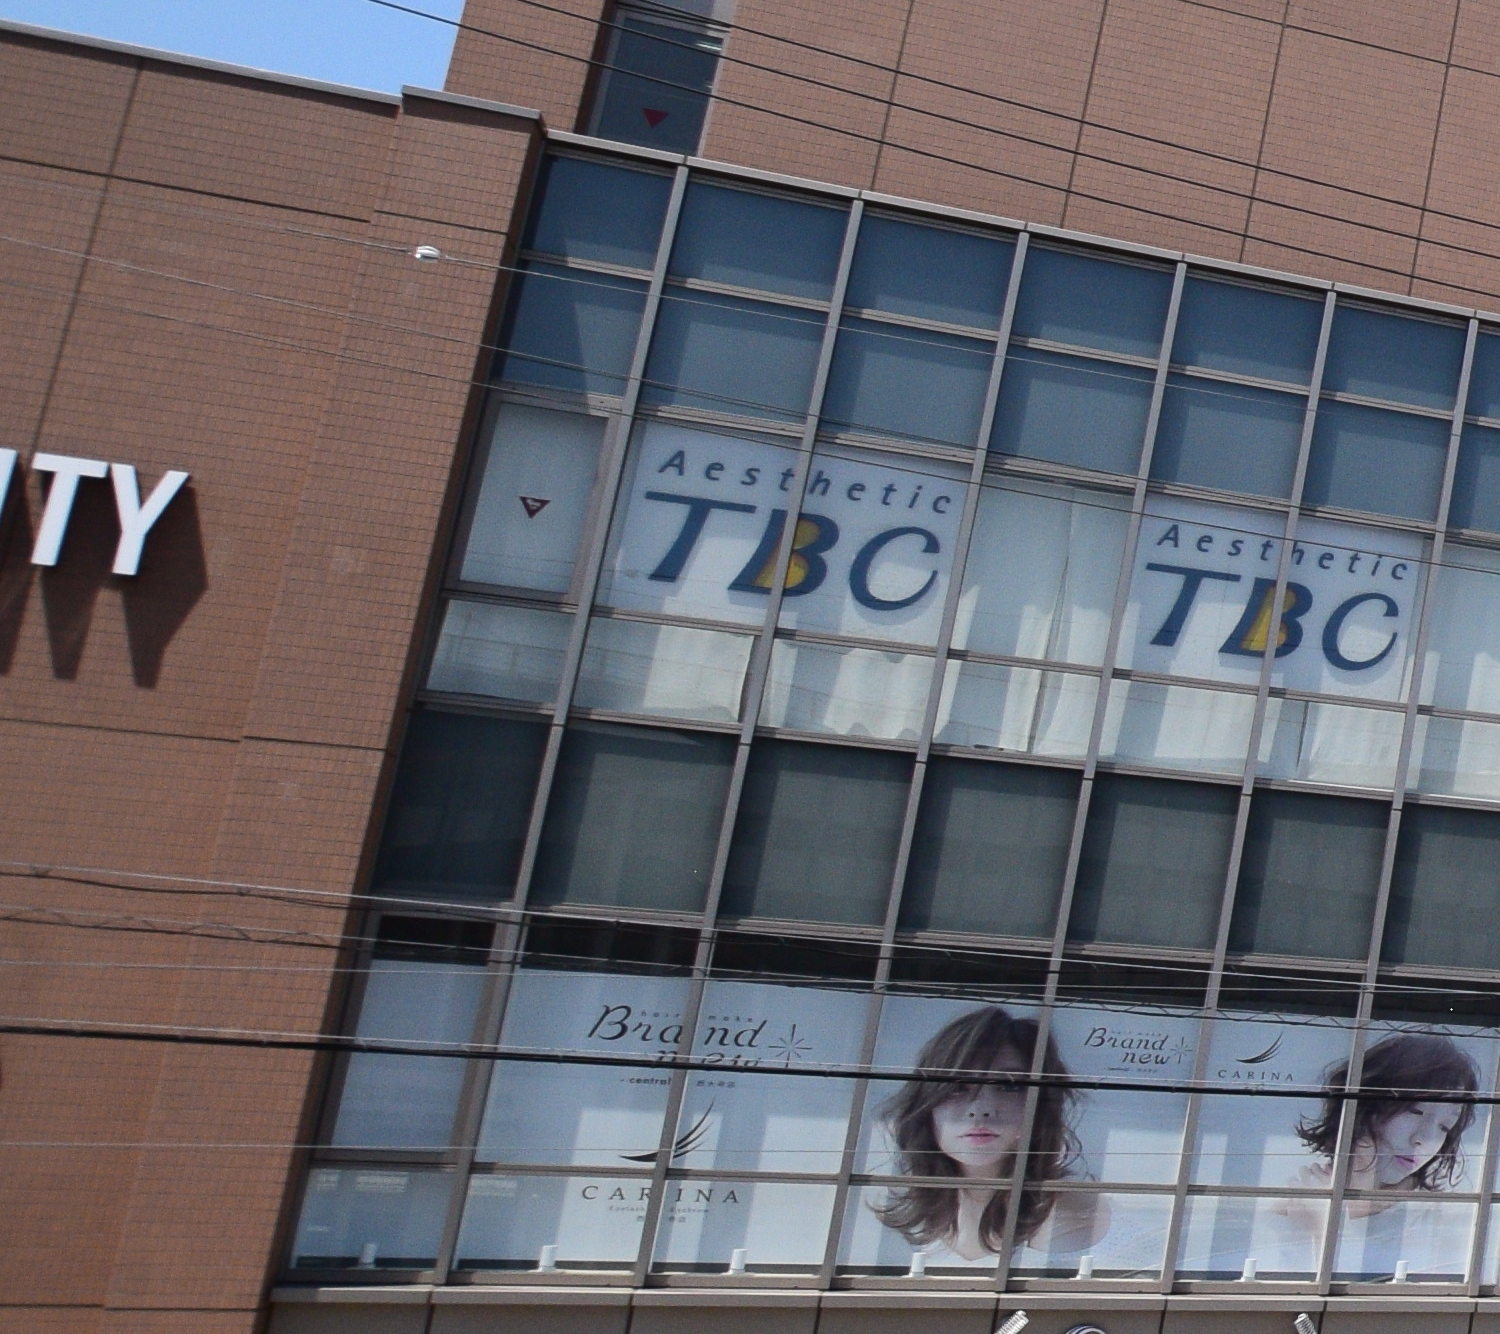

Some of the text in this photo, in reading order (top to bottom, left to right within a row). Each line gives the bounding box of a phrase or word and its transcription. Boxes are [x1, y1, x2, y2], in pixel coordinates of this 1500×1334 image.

[658, 449, 952, 513] Aesthetic
[0, 448, 190, 576] TY
[644, 491, 940, 612] TBC
[1156, 523, 1408, 580] Aesthetic
[1145, 563, 1399, 671] TBC
[588, 1004, 767, 1048] Brand
[1084, 1027, 1169, 1051] Brand
[1122, 1051, 1171, 1065] new
[1217, 1069, 1295, 1082] CARINA
[581, 1185, 740, 1204] CARINA
